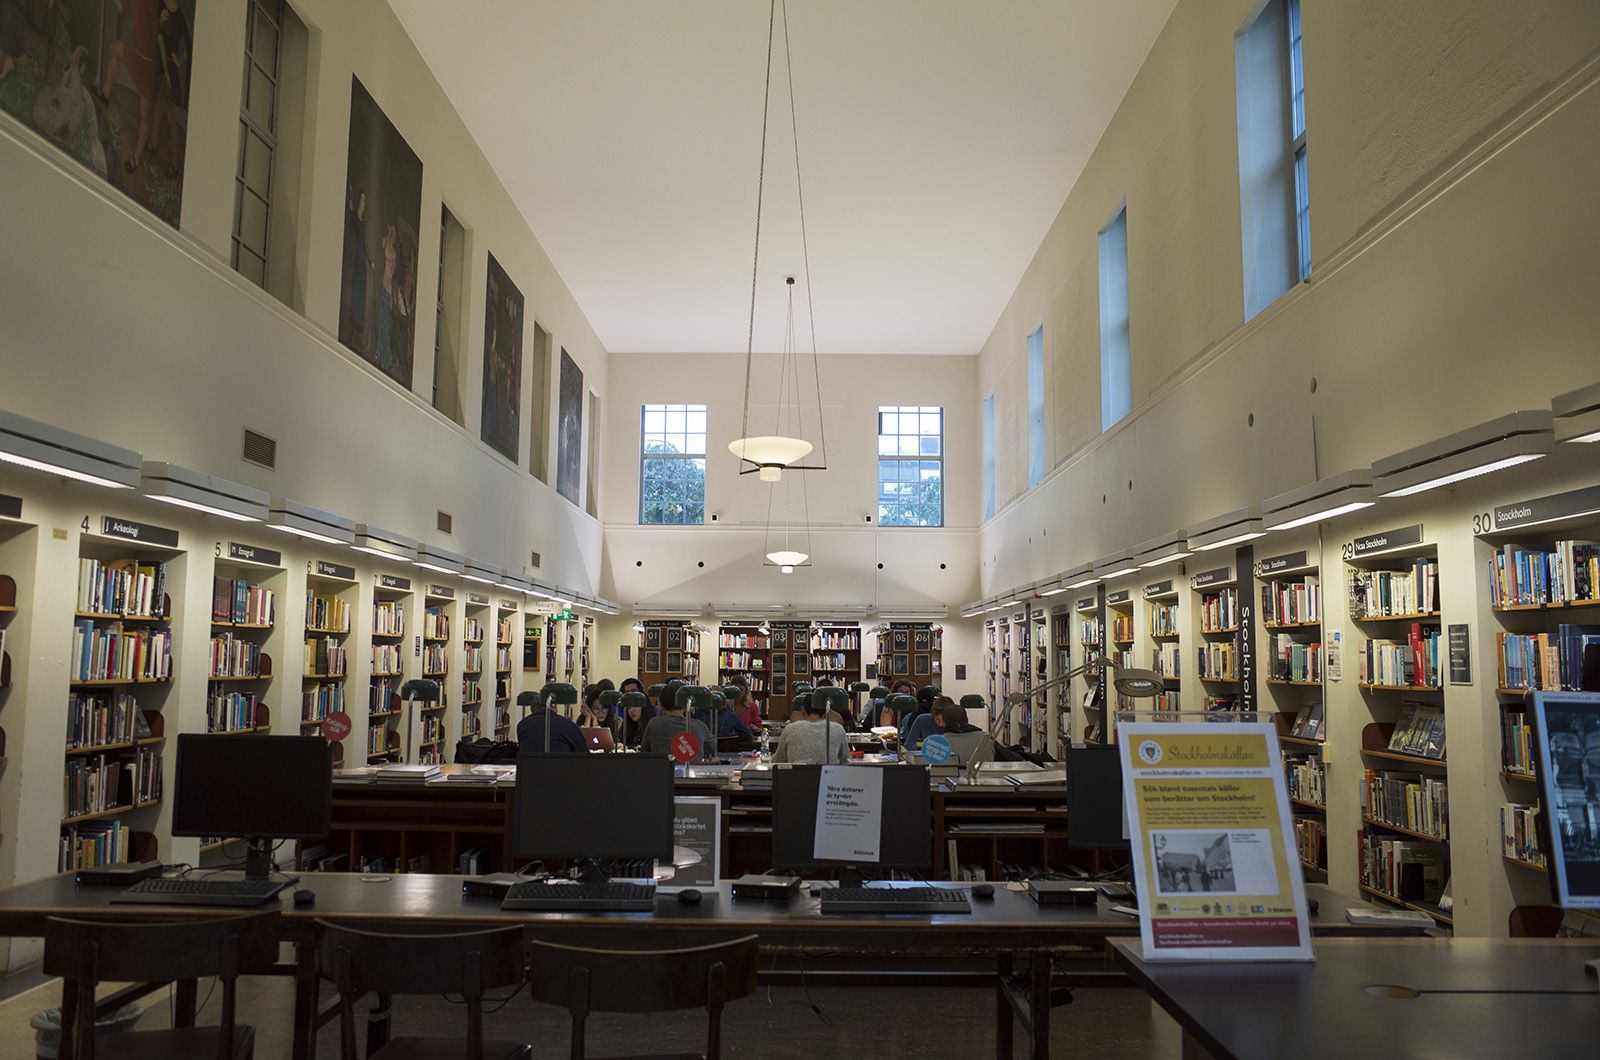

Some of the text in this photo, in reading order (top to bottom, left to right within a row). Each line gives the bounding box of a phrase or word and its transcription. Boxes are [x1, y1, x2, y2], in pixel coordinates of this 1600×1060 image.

[1497, 506, 1532, 522] Stockholm
[81, 515, 90, 533] 4
[112, 522, 139, 537] Arkeologi
[1473, 513, 1491, 534] 30
[1365, 537, 1388, 548] Stockholm
[215, 542, 221, 557] 5
[1342, 543, 1353, 559] 29
[307, 561, 312, 574] 6
[1254, 562, 1262, 576] 28
[1271, 560, 1287, 568] Stockholm
[648, 632, 657, 640] 01
[669, 632, 680, 640] 02
[774, 633, 785, 641] 03
[795, 633, 806, 641] 04
[895, 634, 906, 642] 05
[917, 634, 928, 642] 06
[1241, 606, 1251, 719] Stockholm
[926, 739, 950, 751] Internet
[926, 745, 947, 757] drop-in
[933, 753, 944, 761] min
